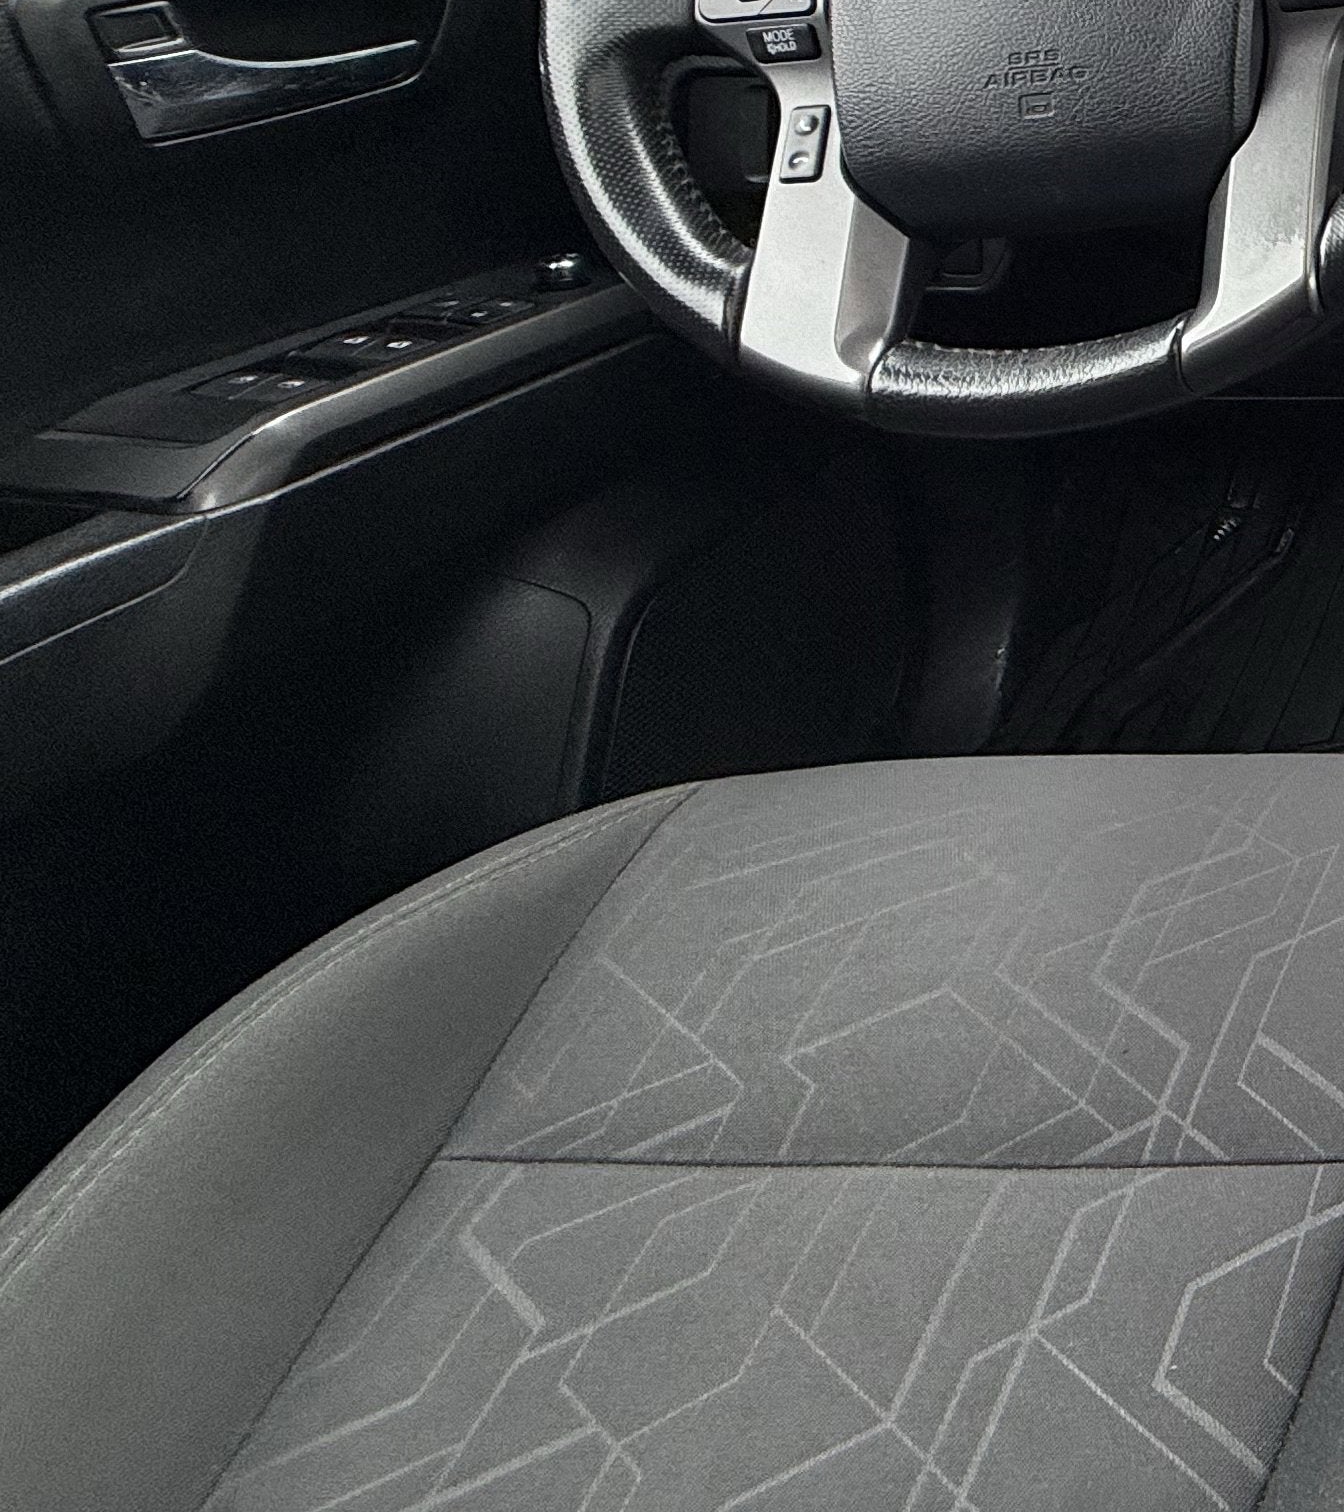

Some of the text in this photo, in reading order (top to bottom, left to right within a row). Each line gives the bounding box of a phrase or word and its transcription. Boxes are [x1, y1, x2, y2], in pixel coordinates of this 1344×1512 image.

[762, 28, 795, 43] MODE
[1008, 48, 1061, 65] SRS
[983, 65, 1090, 89] AIRBAG
